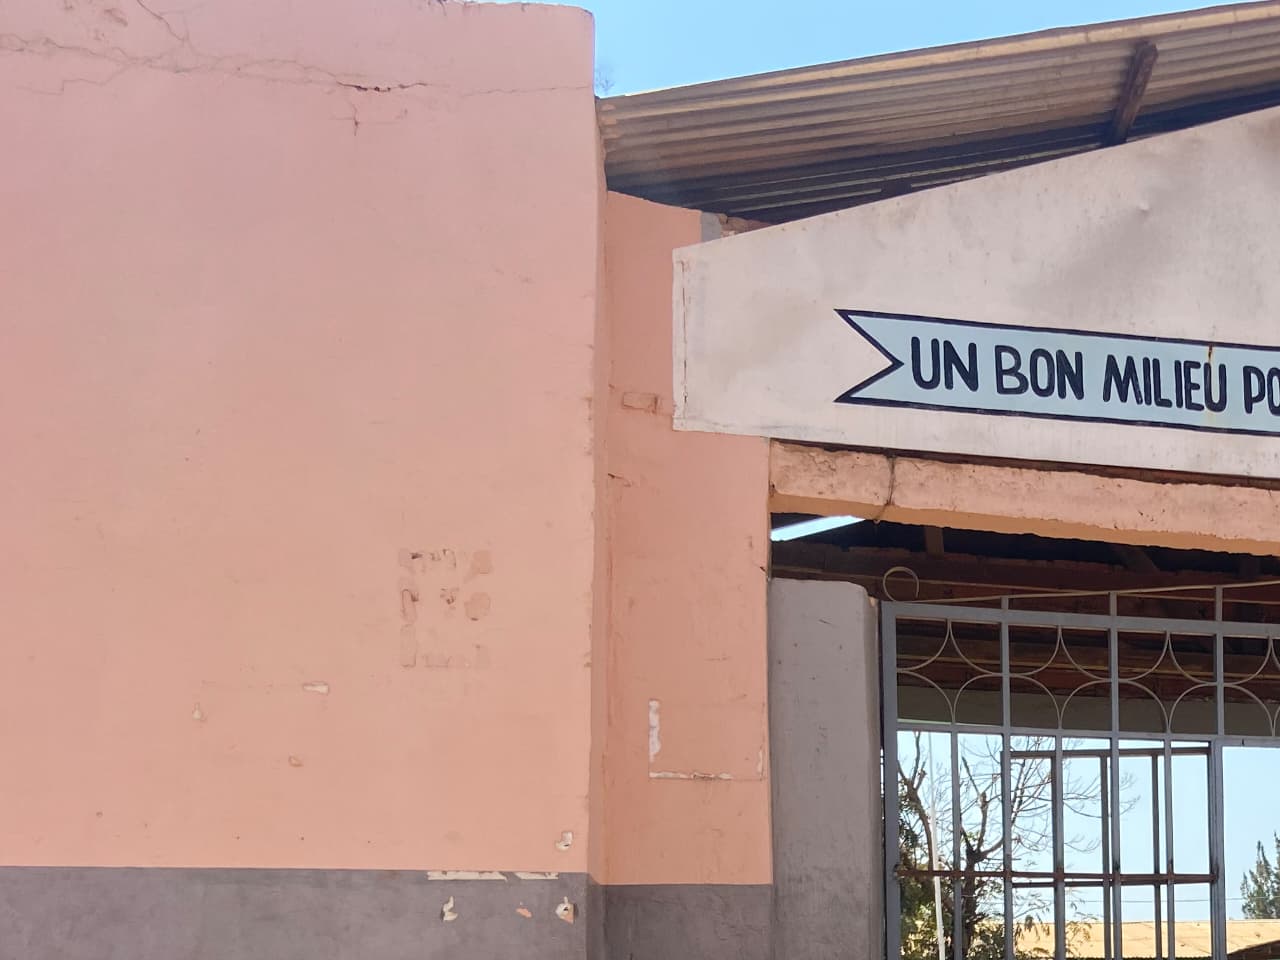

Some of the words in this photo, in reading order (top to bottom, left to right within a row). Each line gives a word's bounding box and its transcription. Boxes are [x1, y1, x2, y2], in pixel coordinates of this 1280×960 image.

[910, 335, 979, 393] UN
[994, 344, 1085, 400] BON
[1102, 353, 1228, 413] MILIEU
